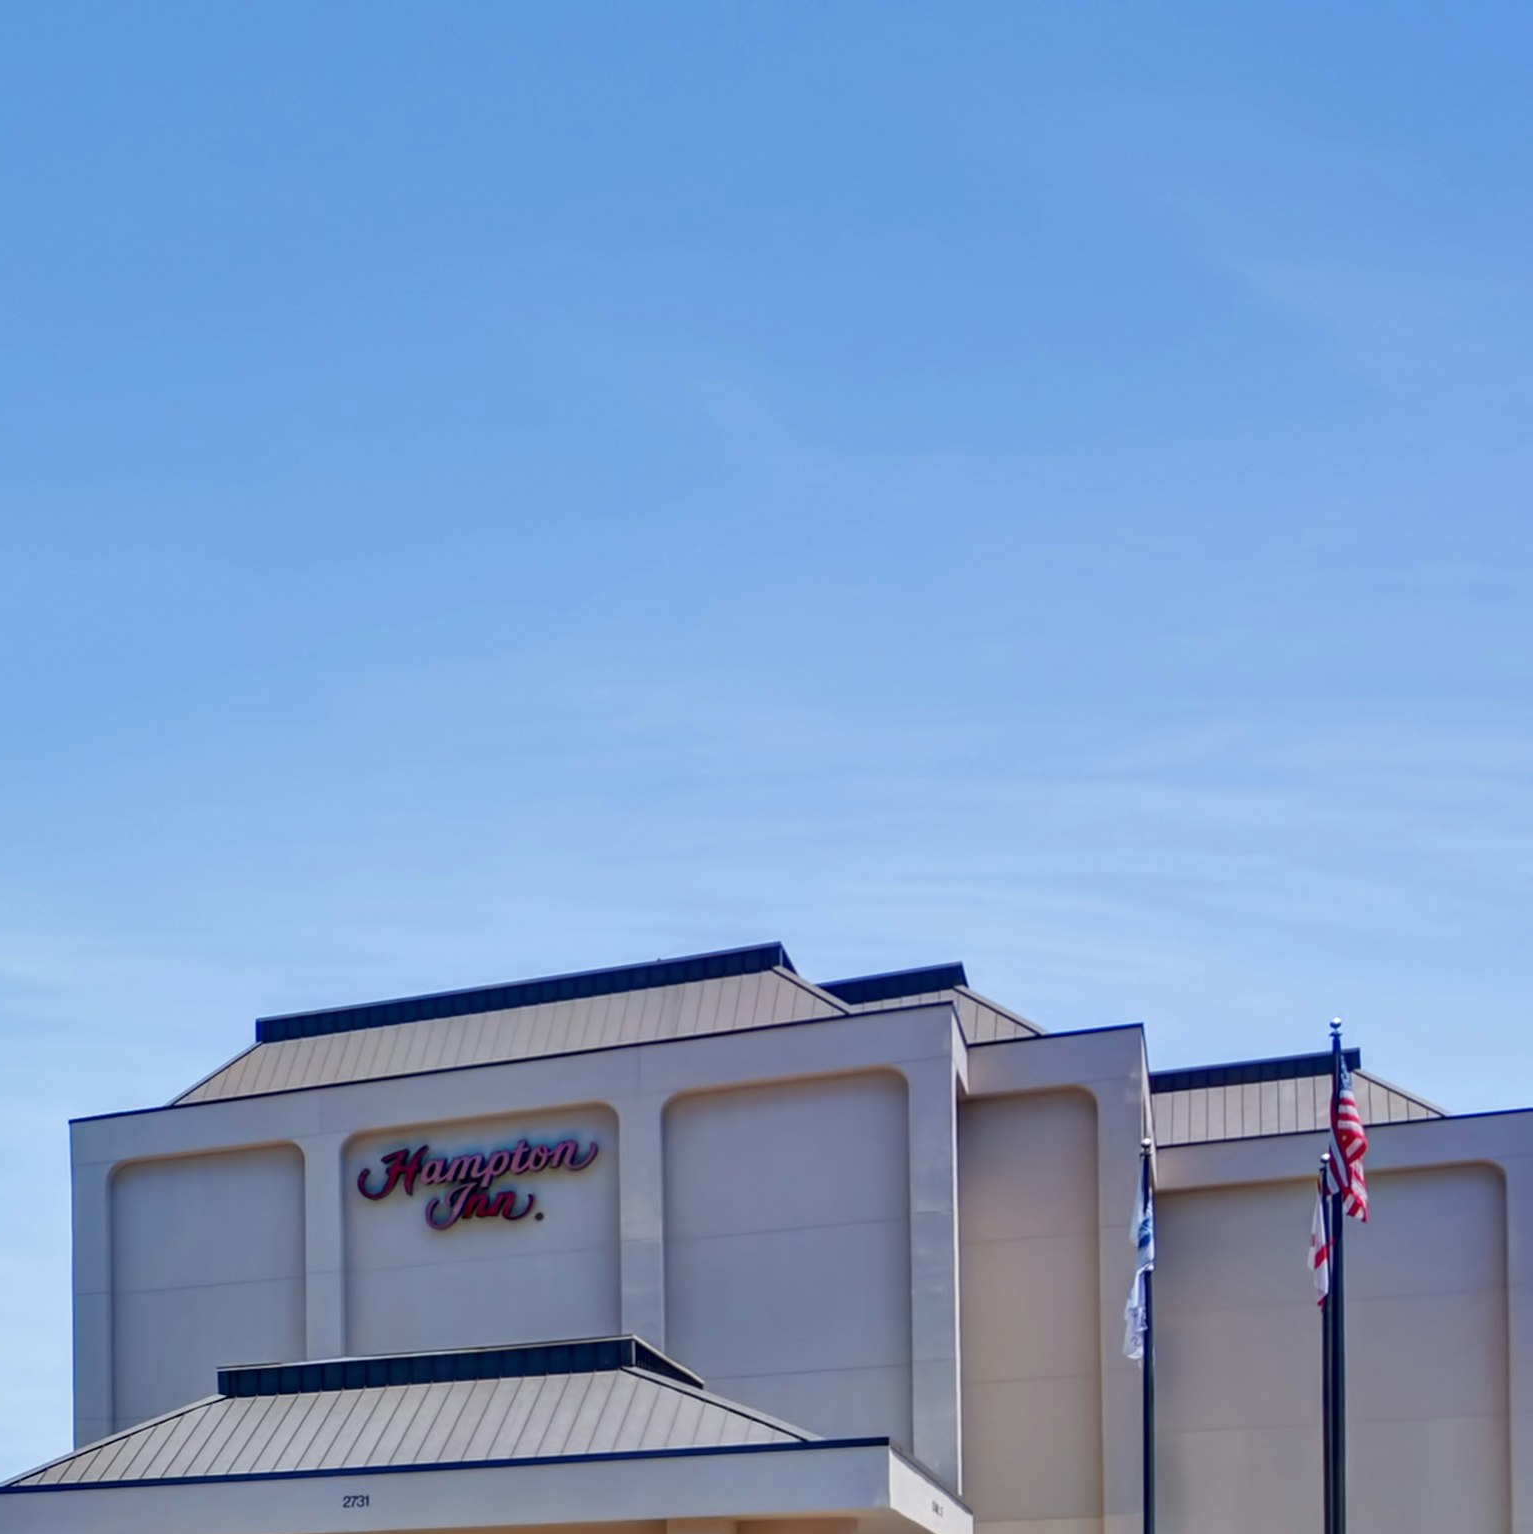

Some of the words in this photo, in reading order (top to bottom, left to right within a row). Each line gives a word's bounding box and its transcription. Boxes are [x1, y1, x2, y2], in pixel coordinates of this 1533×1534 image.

[357, 1139, 599, 1201] Hampton
[425, 1182, 535, 1230] Inn
[343, 1495, 369, 1508] 2731
